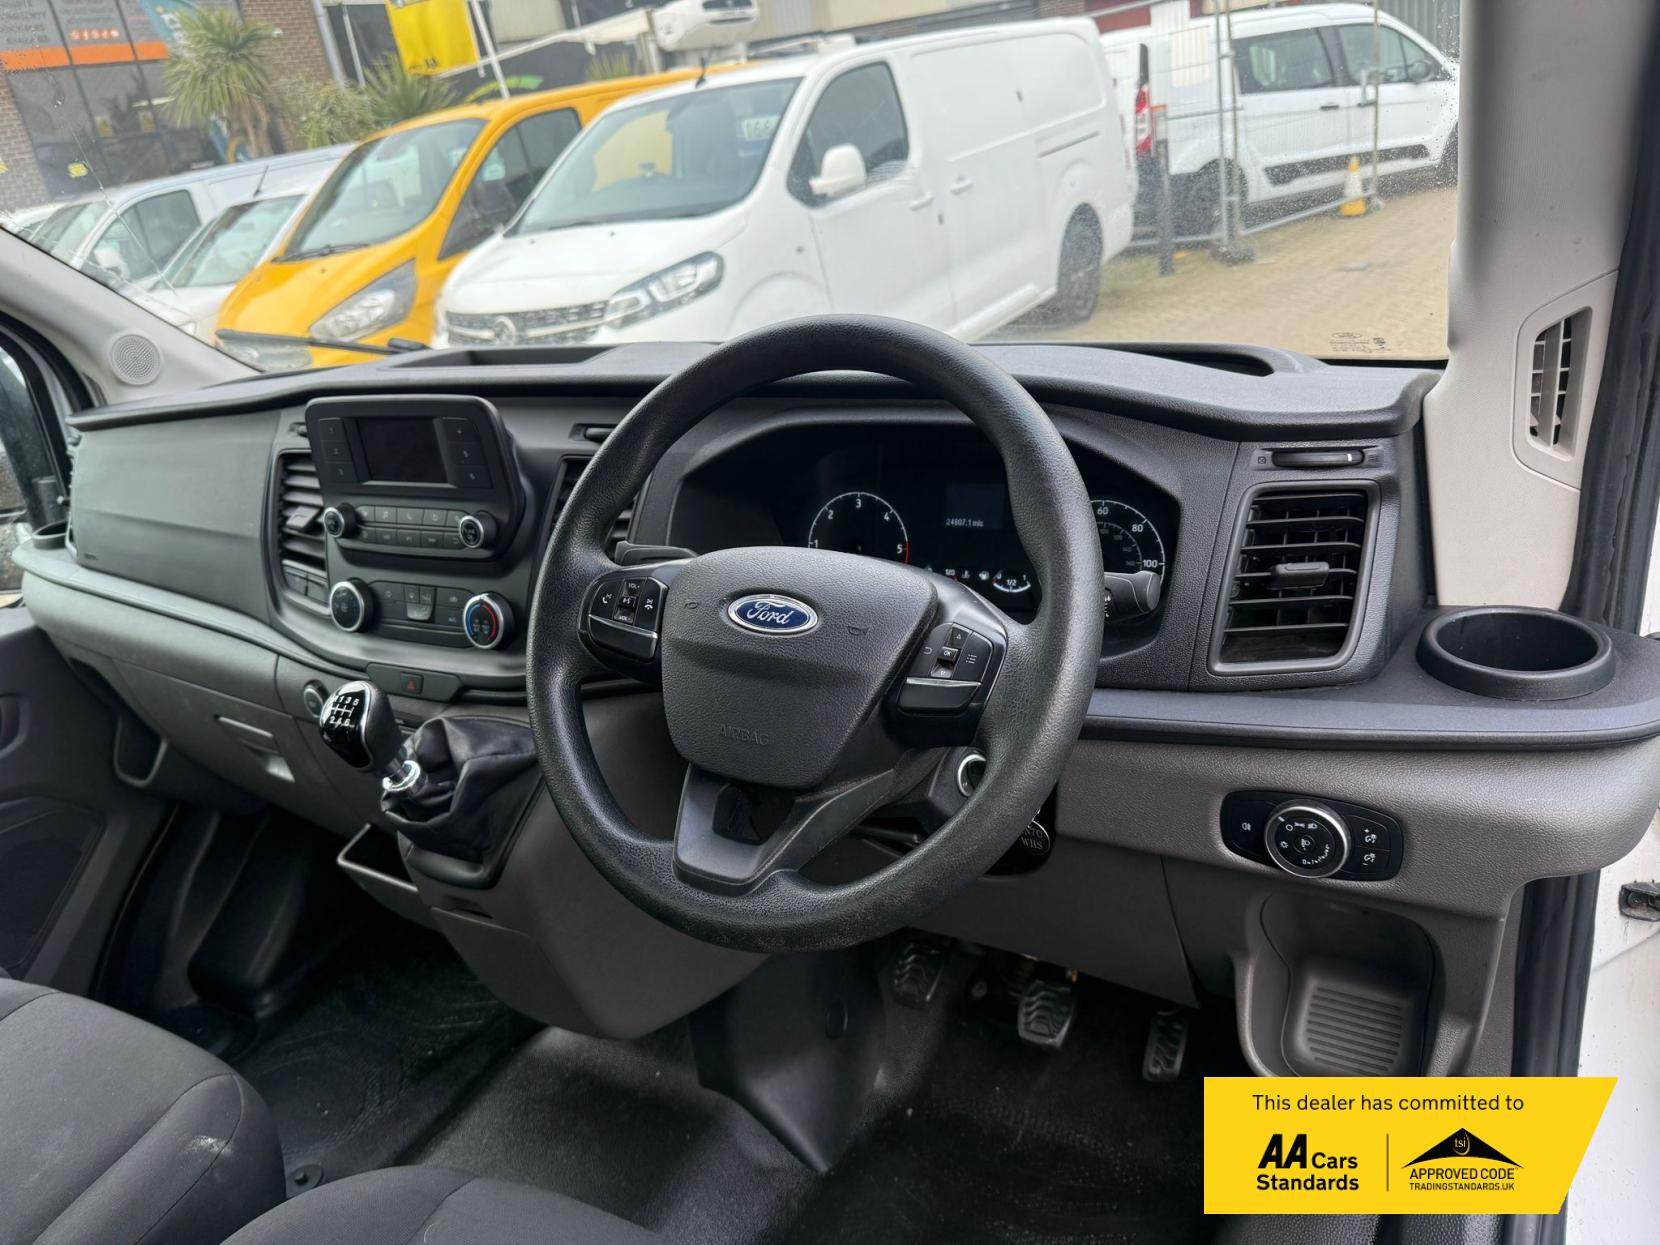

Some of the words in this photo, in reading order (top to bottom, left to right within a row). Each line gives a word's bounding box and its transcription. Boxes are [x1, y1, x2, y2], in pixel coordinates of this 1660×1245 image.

[855, 498, 862, 508] 3
[828, 510, 834, 520] 2
[1097, 506, 1109, 515] 60
[883, 512, 890, 521] 4
[1131, 524, 1144, 532] 80
[814, 540, 819, 548] 1
[896, 544, 903, 554] 5
[1142, 560, 1158, 568] 100
[1006, 579, 1017, 587] 1/2
[746, 601, 794, 625] Ford
[720, 723, 769, 746] AIRBAG
